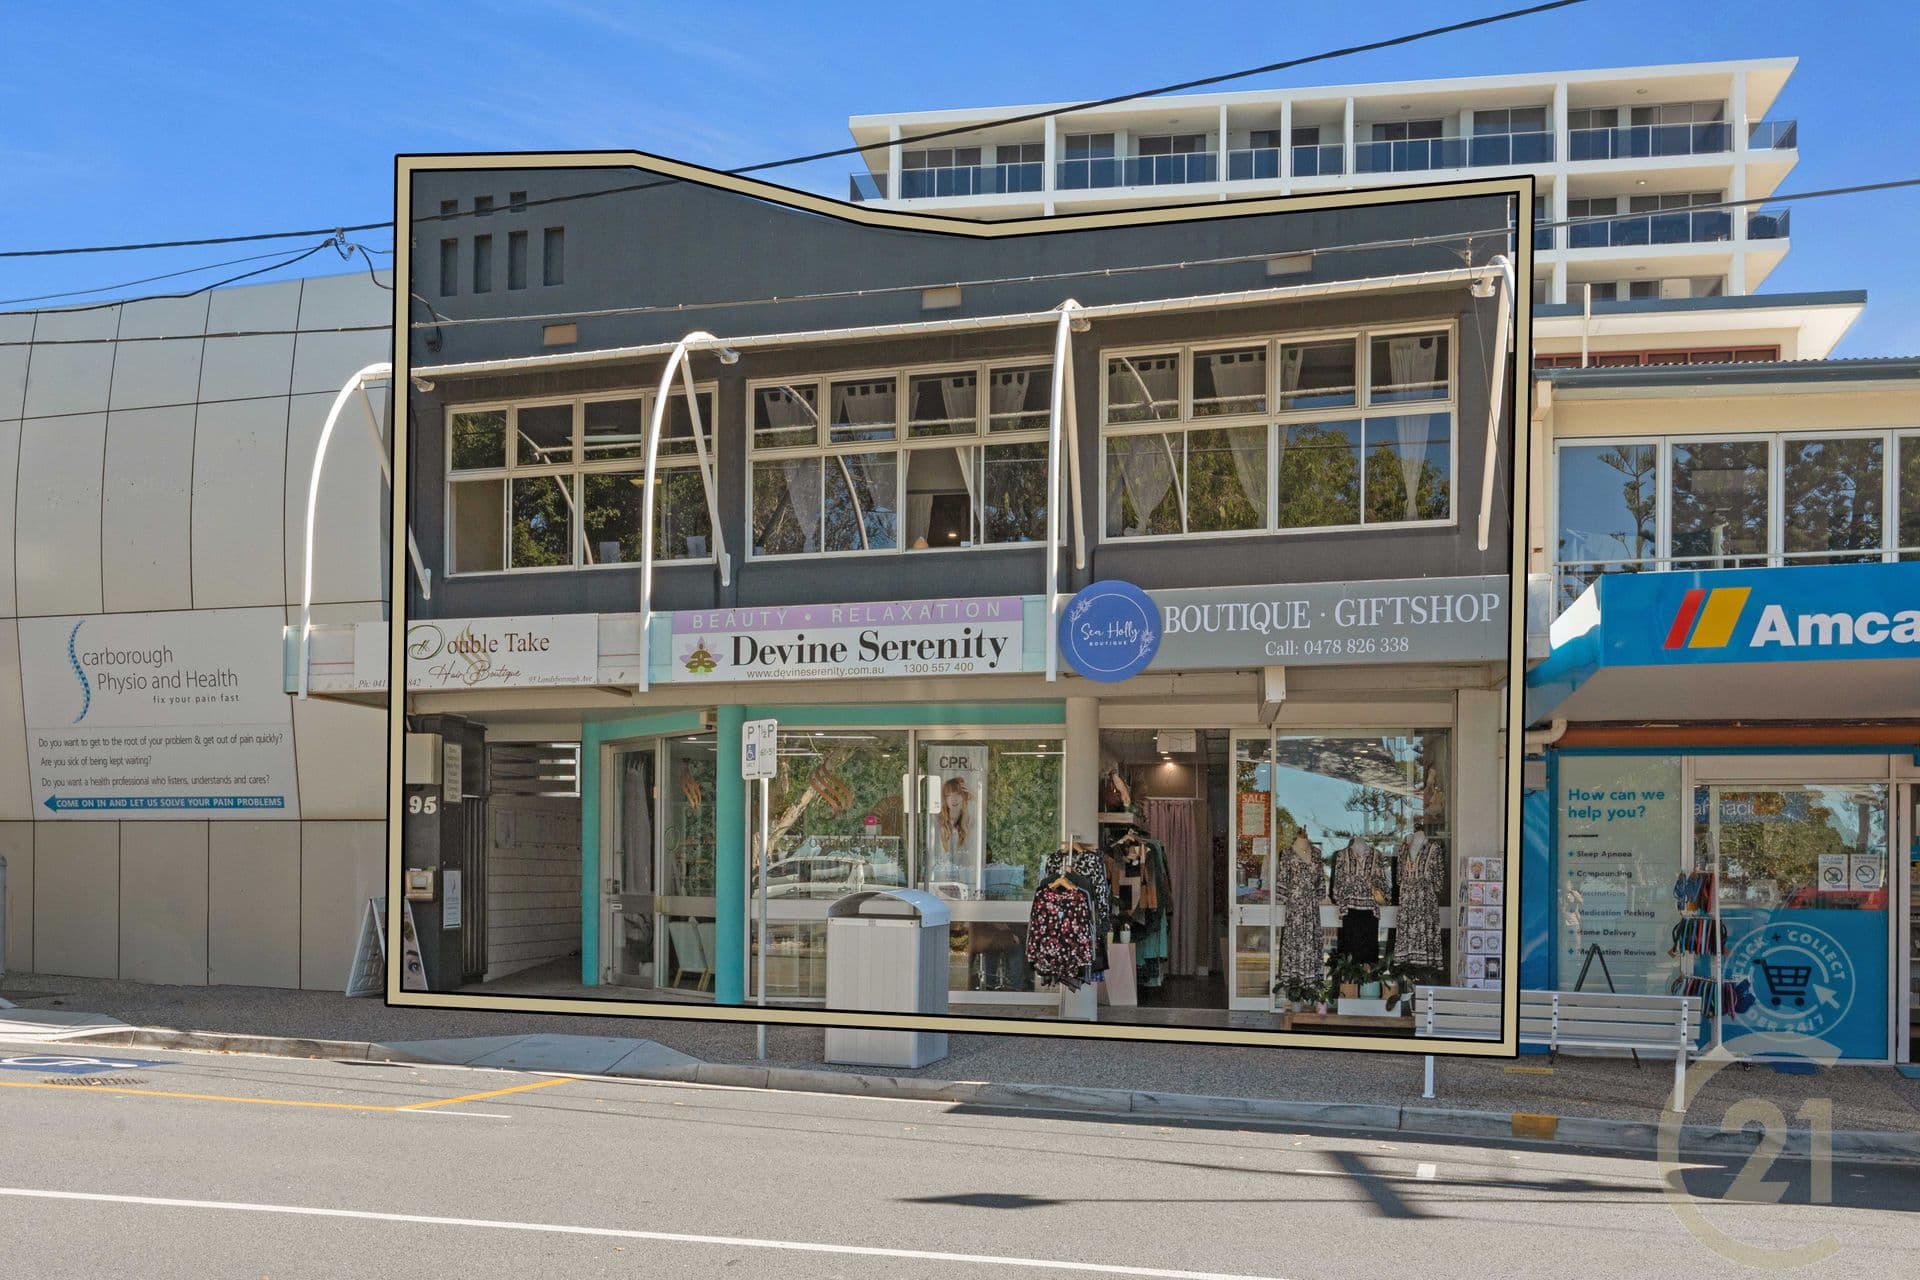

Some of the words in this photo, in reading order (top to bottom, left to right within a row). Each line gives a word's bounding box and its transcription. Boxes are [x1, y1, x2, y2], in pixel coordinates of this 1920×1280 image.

[693, 610, 788, 628] BEAUTY
[832, 602, 1000, 623] RELAXATION
[1163, 601, 1311, 634] BOUTIQUE
[1334, 593, 1500, 627] GIFTSHOP
[1081, 622, 1105, 640] Sea
[1107, 620, 1138, 643] Holly
[505, 632, 550, 653] Take
[731, 633, 848, 666] Devine
[858, 627, 1008, 668] Serenity
[1265, 640, 1299, 657] Call:
[1304, 639, 1343, 656] 0478
[1346, 638, 1376, 655] 826
[1379, 636, 1409, 653] 338
[429, 660, 464, 685] Hair
[462, 659, 522, 686] Boutique
[747, 665, 885, 679] www.devineserenity.com.au
[904, 663, 929, 673] 1300
[931, 663, 950, 673] 557
[954, 662, 974, 672] 400
[98, 672, 147, 694] Physio
[151, 670, 181, 689] and
[186, 668, 238, 688] Health
[153, 695, 166, 703] fix
[169, 696, 191, 704] your
[195, 694, 217, 704] pain
[220, 693, 240, 702] fast
[747, 726, 755, 739] P
[39, 738, 48, 747] Do
[50, 740, 62, 749] you
[64, 739, 79, 747] want
[81, 739, 88, 747] to
[90, 739, 100, 749] get
[102, 738, 110, 746] to
[112, 738, 122, 746] the
[124, 738, 138, 746] root
[140, 736, 147, 745] of
[149, 738, 162, 748] your
[165, 735, 192, 748] problem
[194, 735, 201, 745] &
[203, 736, 214, 747] get
[216, 736, 228, 744] out
[231, 734, 237, 744] of
[239, 736, 253, 747] pain
[256, 733, 283, 746] quickly?
[41, 758, 51, 766] Are
[53, 759, 66, 768] you
[67, 757, 79, 766] sick
[81, 756, 88, 765] of
[90, 756, 107, 768] being
[109, 756, 123, 767] kept
[125, 755, 152, 767] waiting?
[940, 756, 967, 769] CPR
[41, 778, 51, 787] Do
[53, 779, 66, 788] you
[67, 778, 82, 786] want
[90, 777, 111, 786] health
[112, 776, 149, 787] professional
[151, 776, 166, 785] who
[191, 775, 232, 785] understands
[234, 775, 247, 784] and
[249, 774, 270, 785] cares?
[1241, 794, 1266, 803] SALE
[1568, 788, 1605, 801] How
[1609, 791, 1636, 801] can
[1641, 791, 1665, 801] we
[56, 799, 79, 808] COME
[81, 799, 94, 807] ON
[97, 799, 106, 807] IN
[109, 799, 127, 807] AND
[130, 799, 144, 807] LET
[147, 799, 158, 807] US
[160, 799, 185, 807] SOLVE
[188, 798, 210, 807] YOUR
[213, 798, 234, 806] PAIN
[237, 798, 282, 806] PROBLEMS
[409, 795, 437, 815] 95
[1568, 805, 1602, 821] help
[1607, 805, 1646, 822] you?
[1576, 850, 1599, 858] Sleep
[1576, 870, 1632, 878] Compounding
[1602, 929, 1636, 938] Delivery
[1624, 949, 1656, 957] Reviews
[1787, 929, 1846, 980] COLLECT
